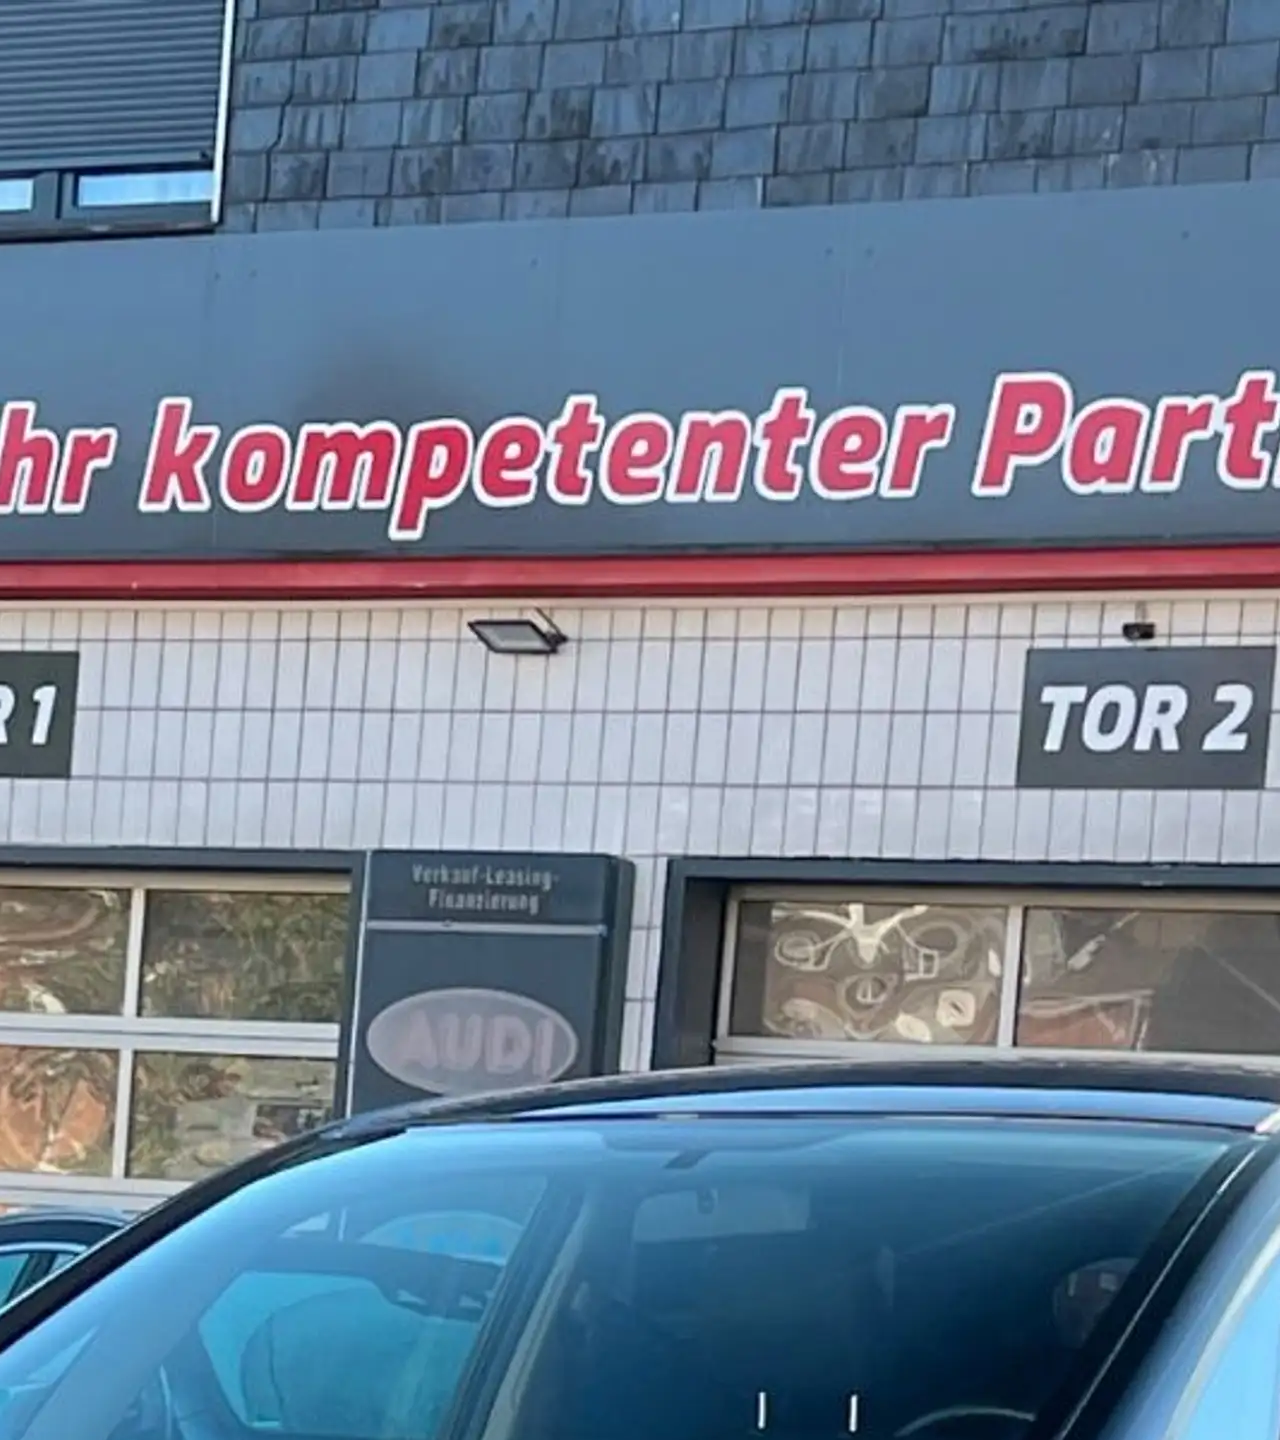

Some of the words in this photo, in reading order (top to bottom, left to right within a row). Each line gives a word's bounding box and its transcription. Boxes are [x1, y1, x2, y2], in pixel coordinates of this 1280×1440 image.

[138, 387, 955, 541] kompetenter
[31, 685, 57, 745] 1
[1040, 684, 1188, 752] TOR
[1202, 684, 1254, 751] 2
[398, 1008, 556, 1077] AUDI
